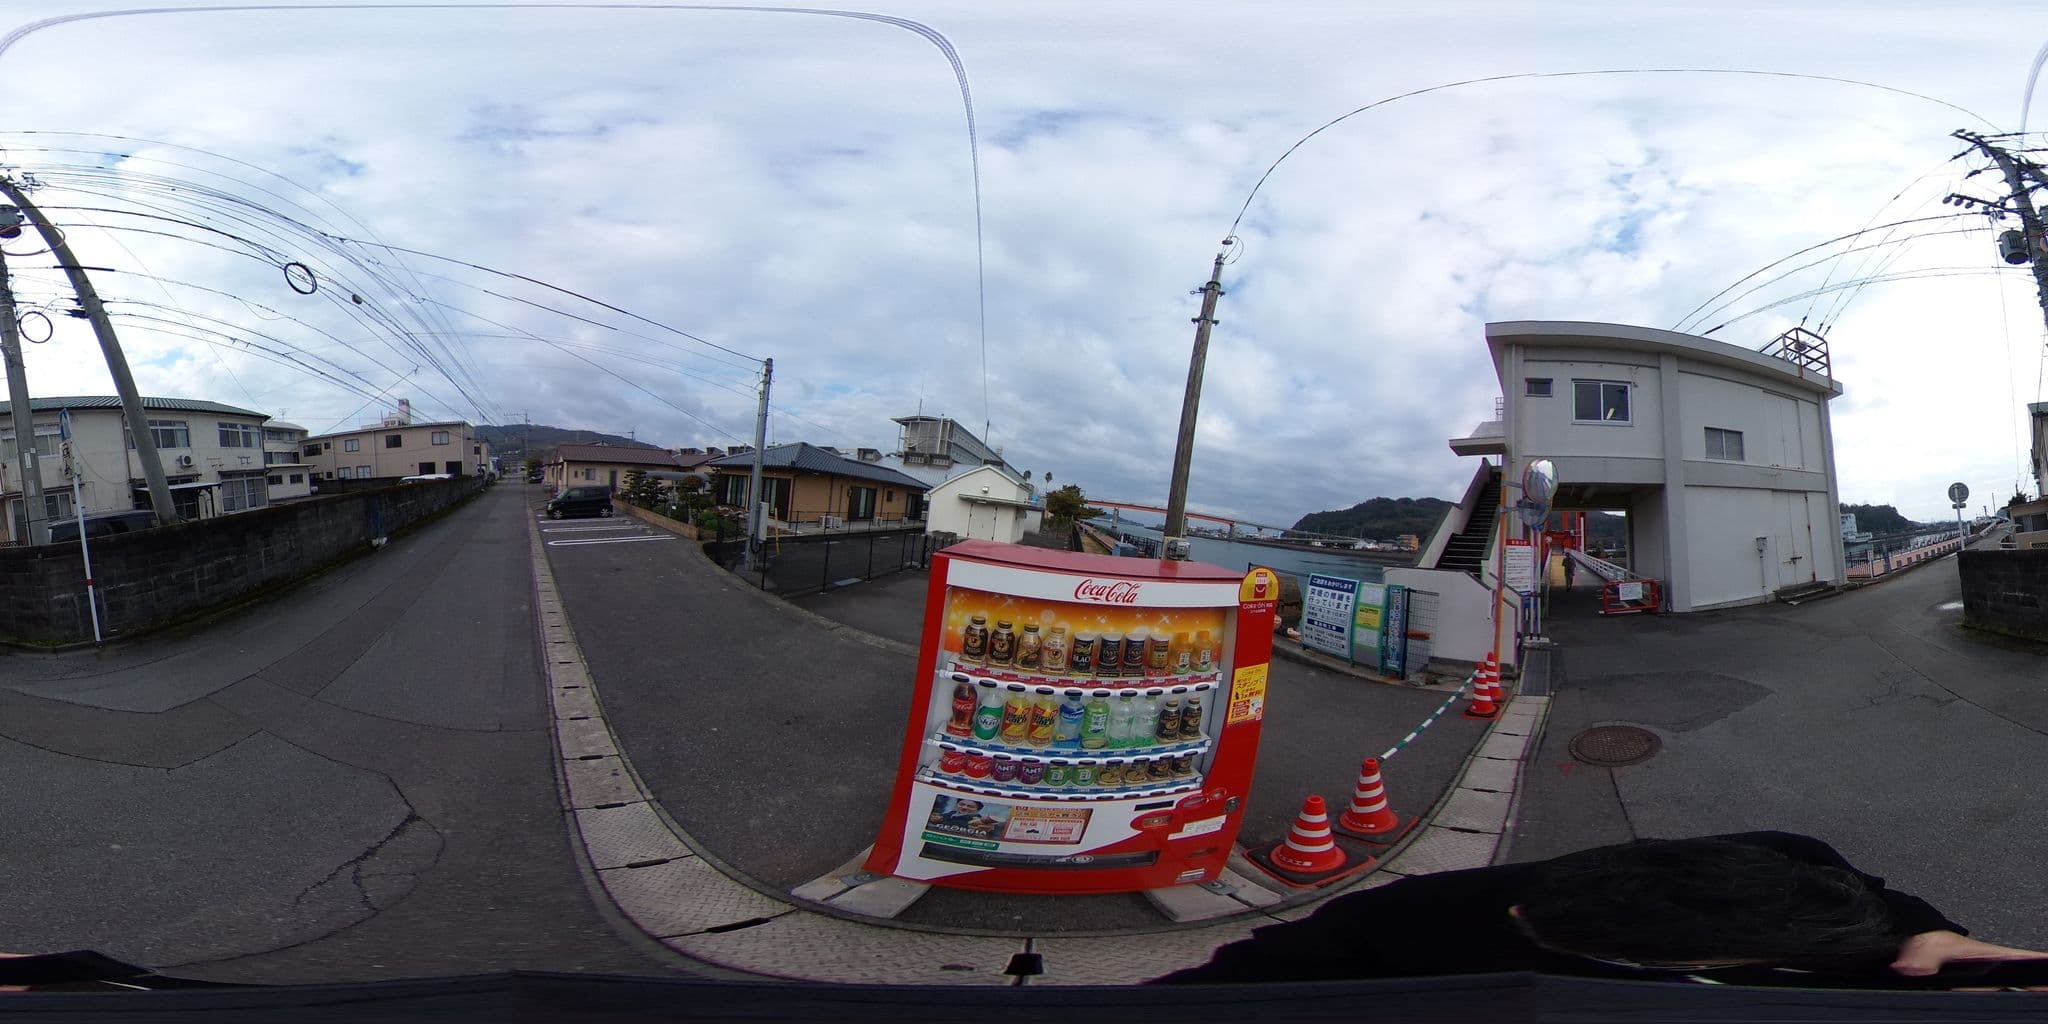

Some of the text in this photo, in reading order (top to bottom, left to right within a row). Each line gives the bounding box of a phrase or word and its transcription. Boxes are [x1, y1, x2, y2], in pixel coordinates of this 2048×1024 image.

[1074, 578, 1141, 604] Coca-Cola
[1308, 596, 1350, 611] 行っています
